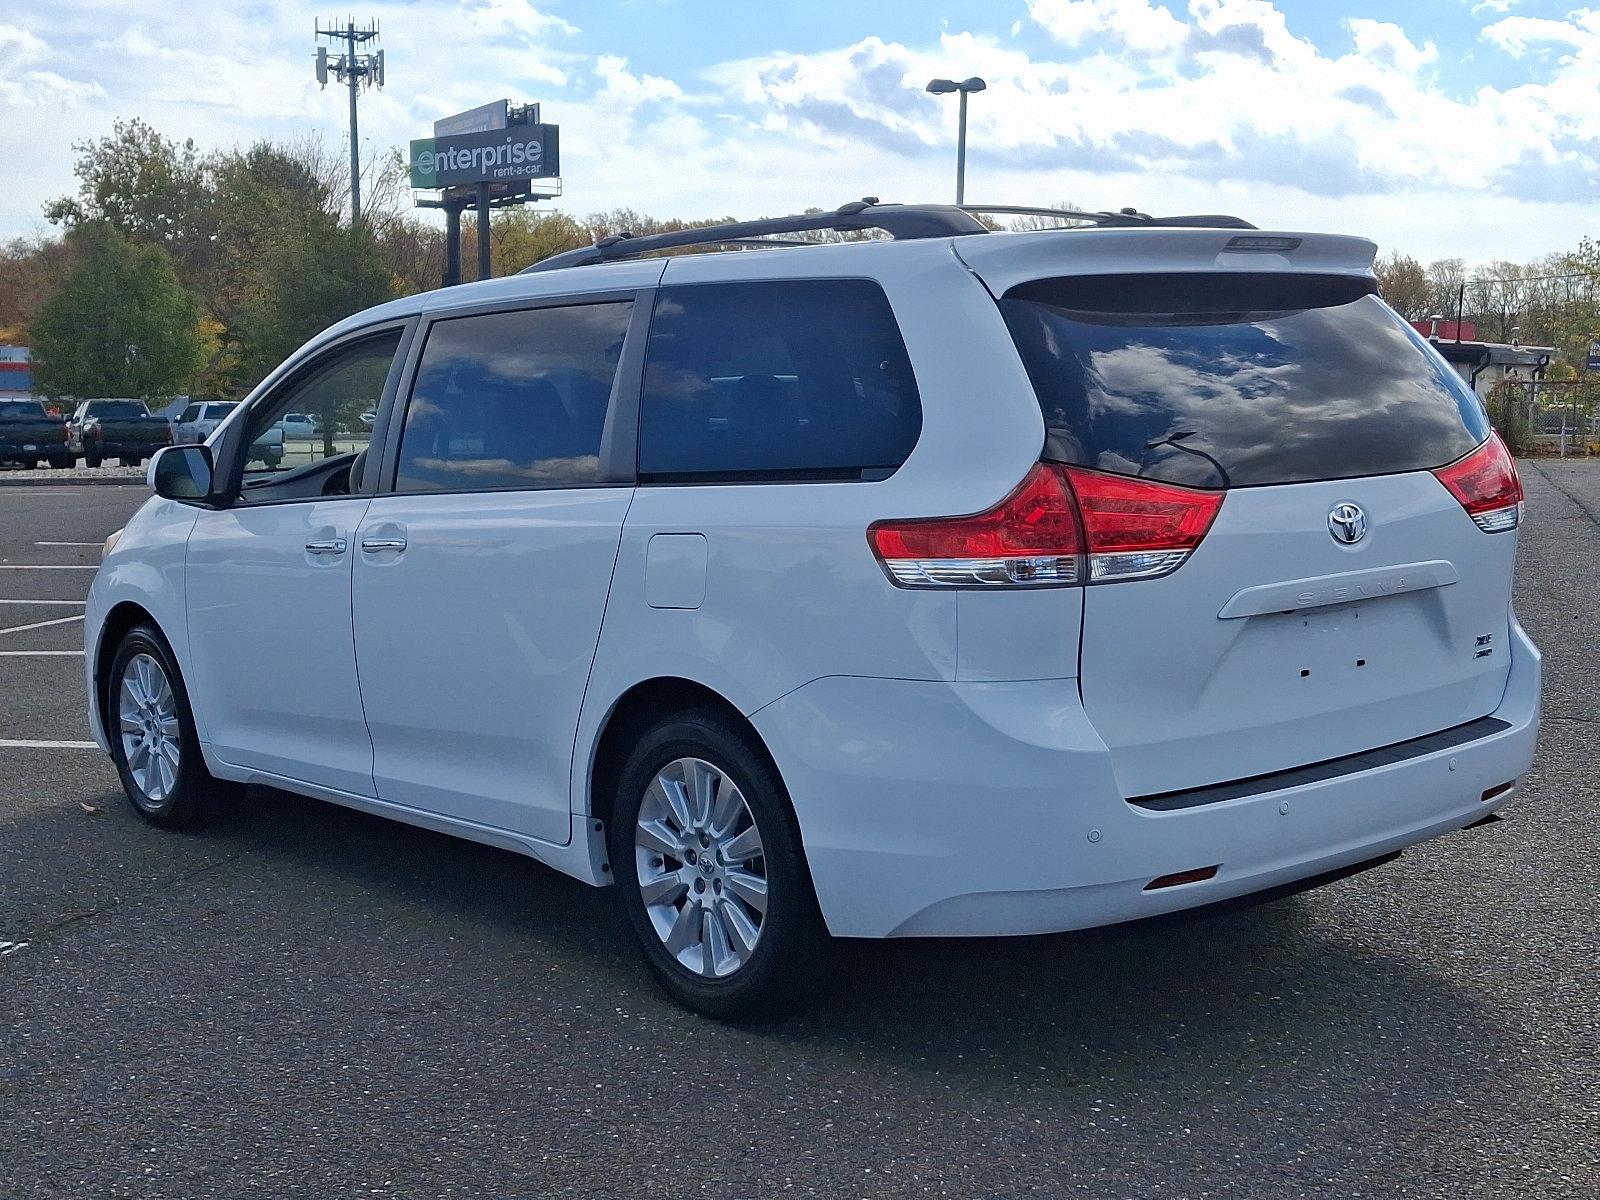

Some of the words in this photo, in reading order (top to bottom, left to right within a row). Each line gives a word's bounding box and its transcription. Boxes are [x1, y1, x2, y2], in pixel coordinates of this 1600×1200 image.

[411, 136, 542, 175] enterprise
[493, 164, 542, 178] rent-a-car
[1295, 575, 1409, 606] SIENNA
